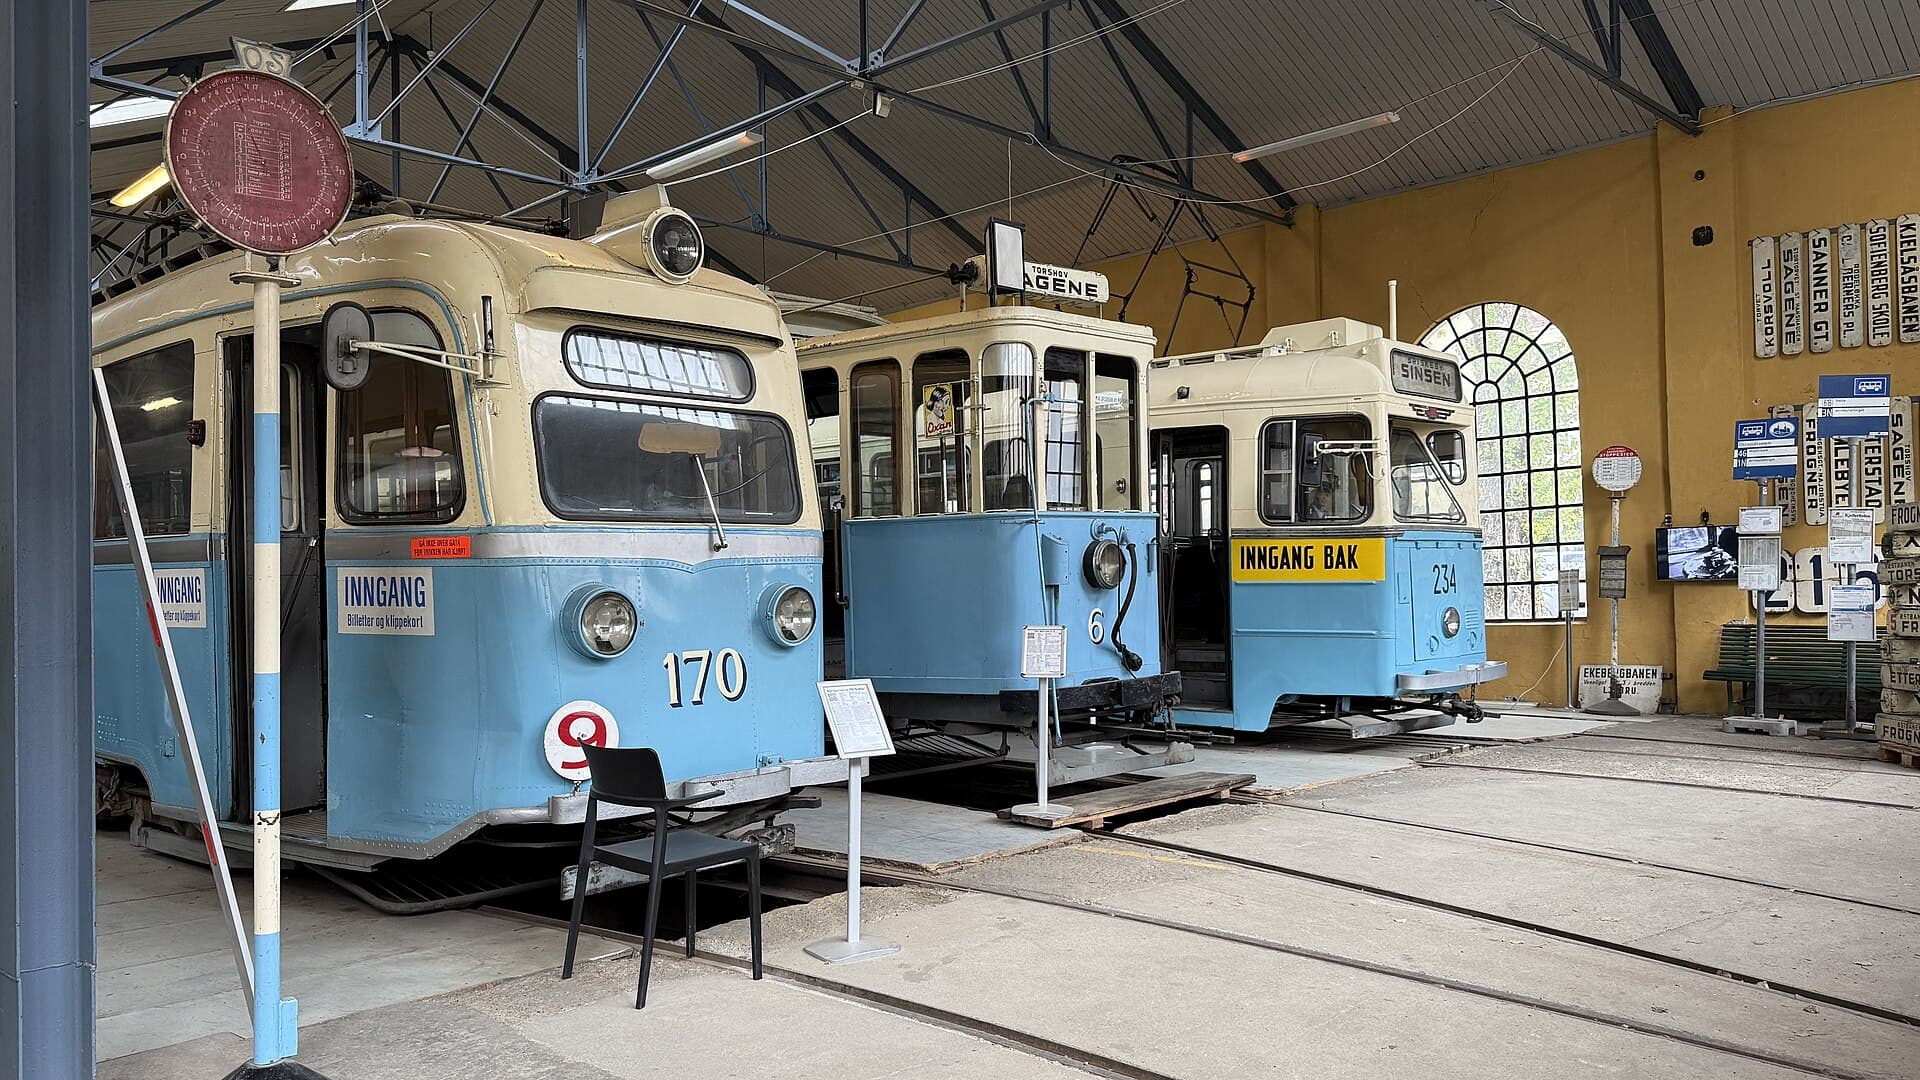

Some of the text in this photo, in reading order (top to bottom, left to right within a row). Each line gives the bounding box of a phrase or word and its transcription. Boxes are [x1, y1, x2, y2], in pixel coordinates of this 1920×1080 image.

[243, 45, 285, 76] OS
[1841, 234, 1852, 265] CL
[1025, 273, 1098, 298] AGENE
[1032, 265, 1068, 279] TORSHOV
[1812, 235, 1829, 346] SANNER GT.
[1869, 225, 1890, 340] SOFIENBERG SKOLE
[1899, 222, 1920, 334] KJELSÅSBANEN
[1761, 258, 1775, 347] KORSVOLL
[1782, 248, 1796, 345] SAGENE
[1401, 363, 1451, 387] SINSEN
[1805, 418, 1818, 510] FROGNER
[1834, 438, 1849, 507] LEBYE
[1864, 438, 1882, 508] TERSTAD
[1240, 544, 1359, 570] INNGANG BAK
[344, 575, 426, 607] INNGANG
[1432, 564, 1457, 595] 234
[347, 613, 424, 629] Billetter og klippekort
[1088, 607, 1105, 646] 6
[663, 648, 748, 708] 170
[1583, 667, 1658, 679] EKEBEGBANEN
[557, 710, 607, 769] 9
